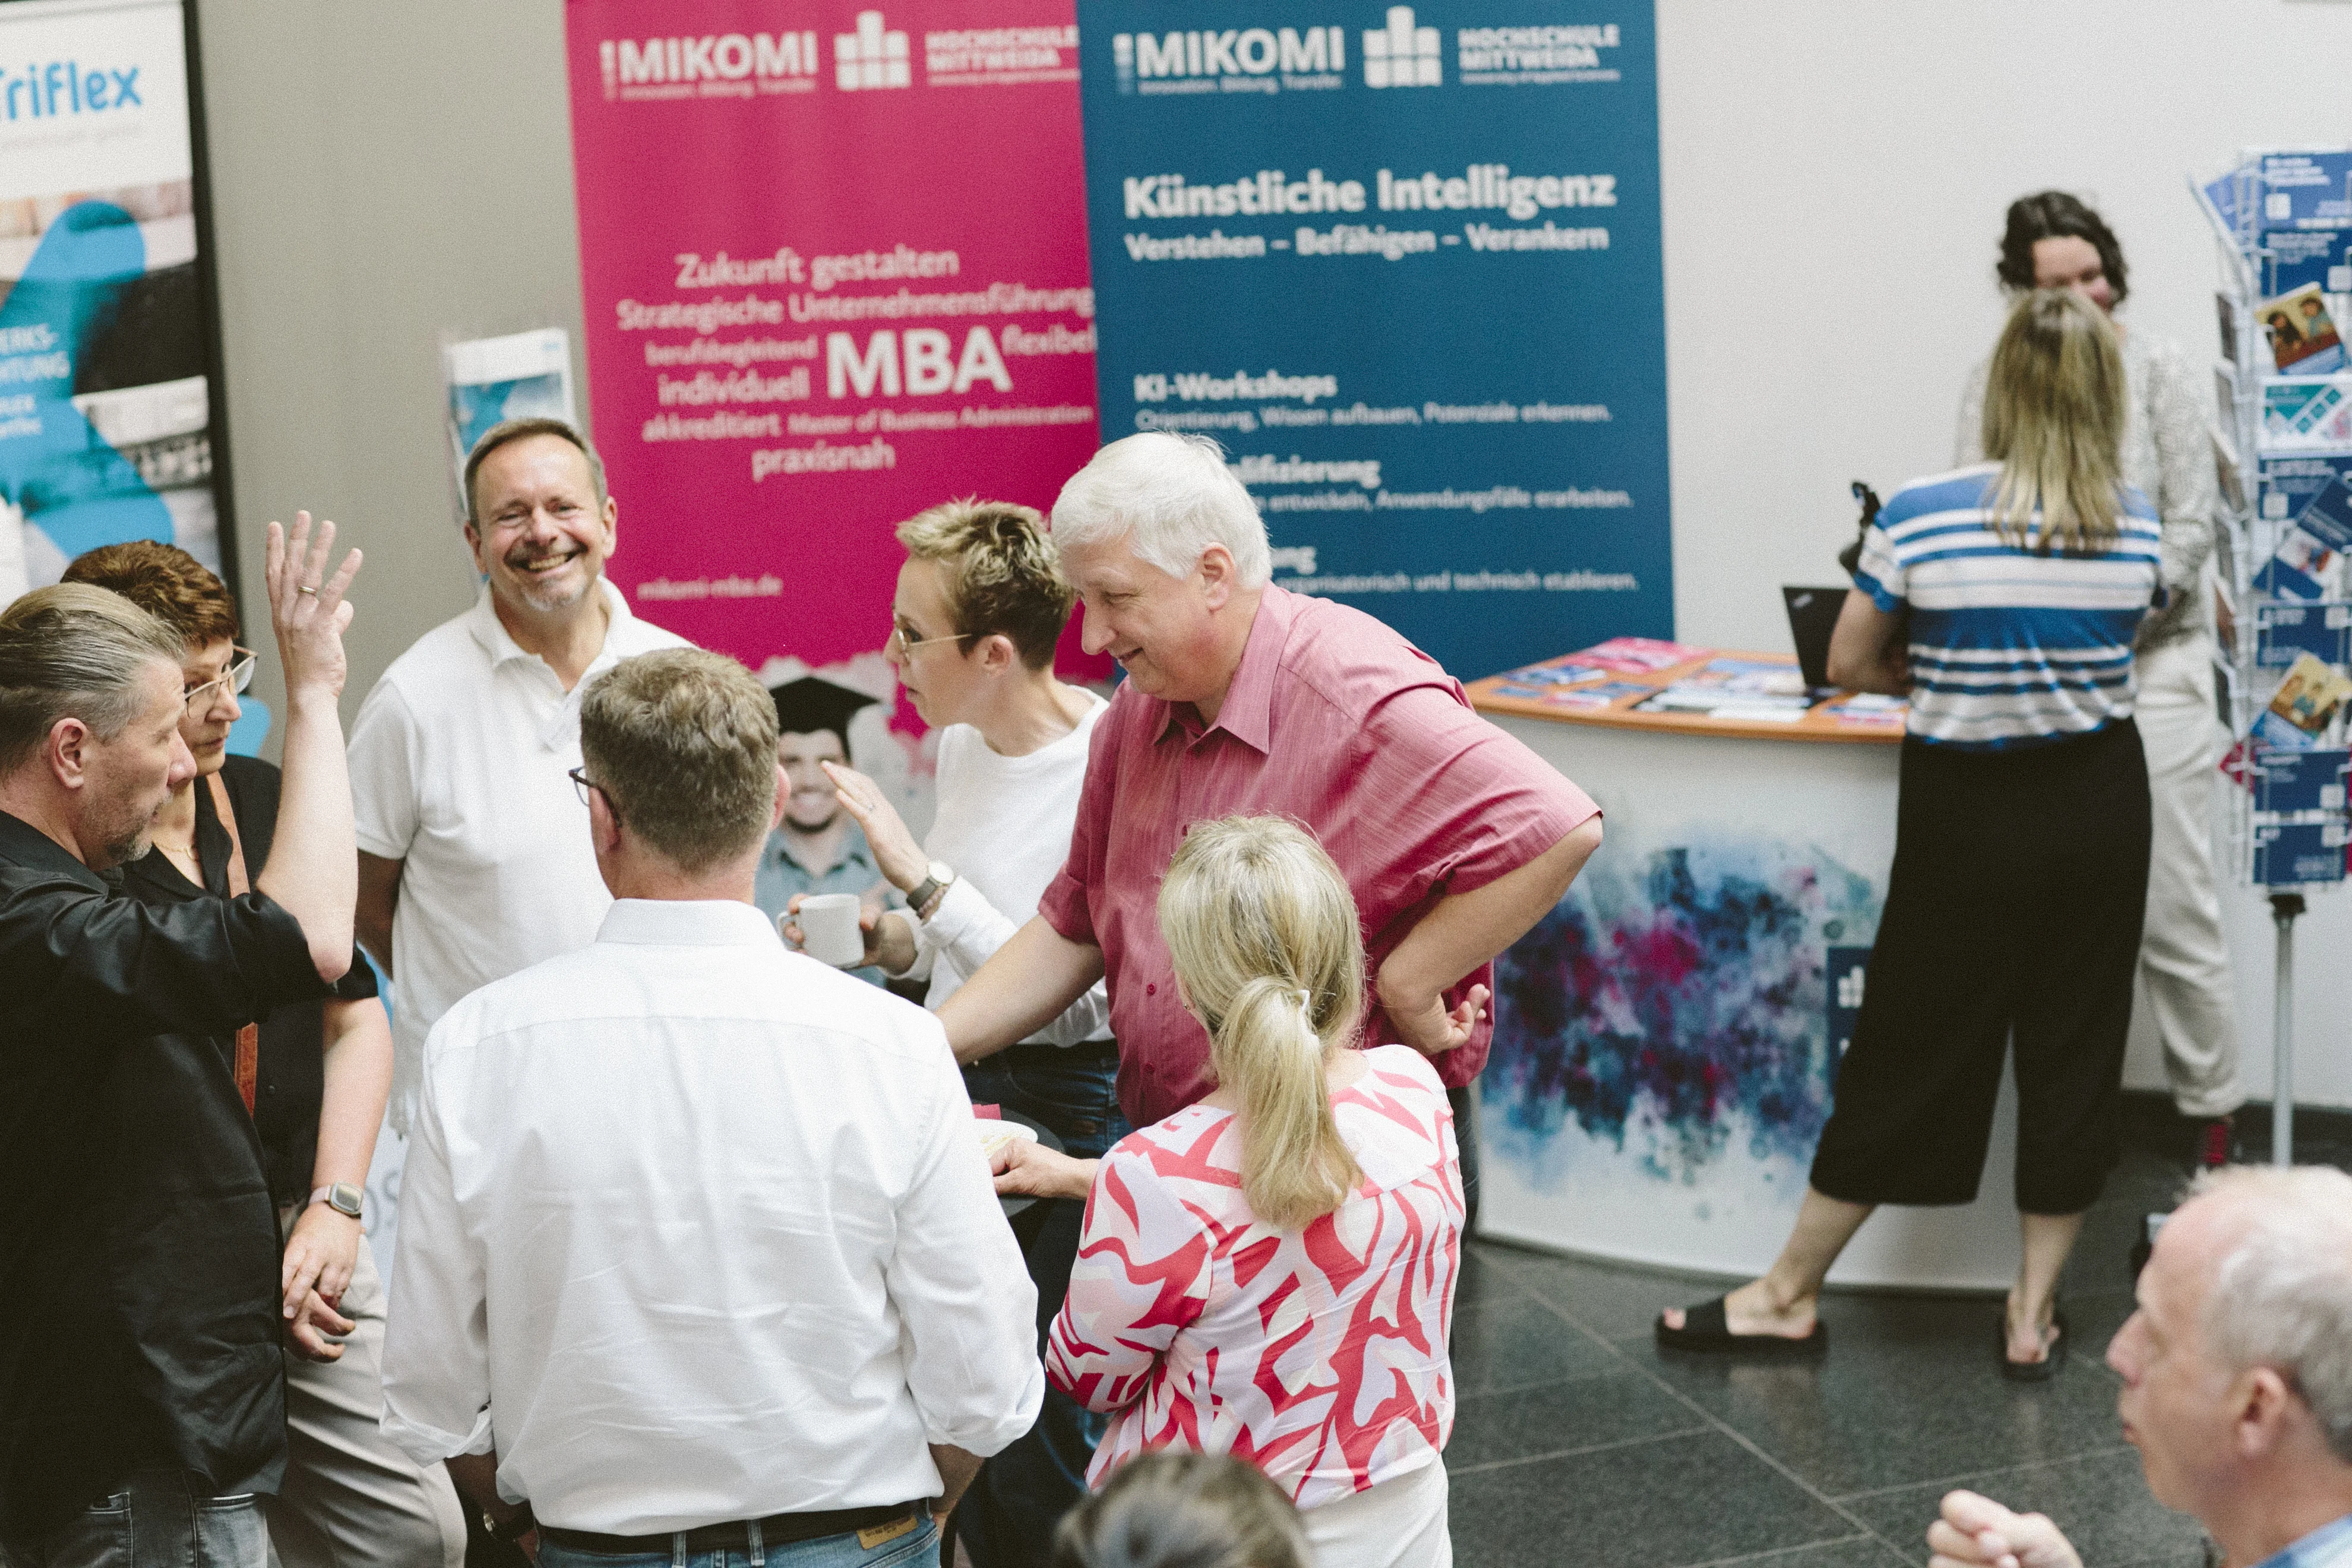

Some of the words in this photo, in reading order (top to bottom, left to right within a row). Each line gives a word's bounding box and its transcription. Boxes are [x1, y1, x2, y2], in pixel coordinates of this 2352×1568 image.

[618, 31, 818, 83] MIKOMI
[1136, 27, 1345, 77] MIKOMI
[0, 62, 142, 121] riflex
[1124, 169, 1366, 219] Künstliche
[1377, 165, 1617, 220] Intelligenz
[1124, 230, 1266, 260] Verstehen
[1295, 225, 1436, 260] Befähigen
[1465, 221, 1610, 251] Verankern
[675, 246, 805, 289] Zukunft
[811, 244, 959, 290] gestalten
[616, 295, 784, 334] Strategische
[789, 282, 1095, 322] Unternehmensführung
[658, 365, 811, 406] individuell
[826, 325, 1013, 399] MBA
[1134, 370, 1338, 404] KI-Workshops
[642, 411, 782, 442] akkreditiert
[752, 437, 896, 482] praxisnah
